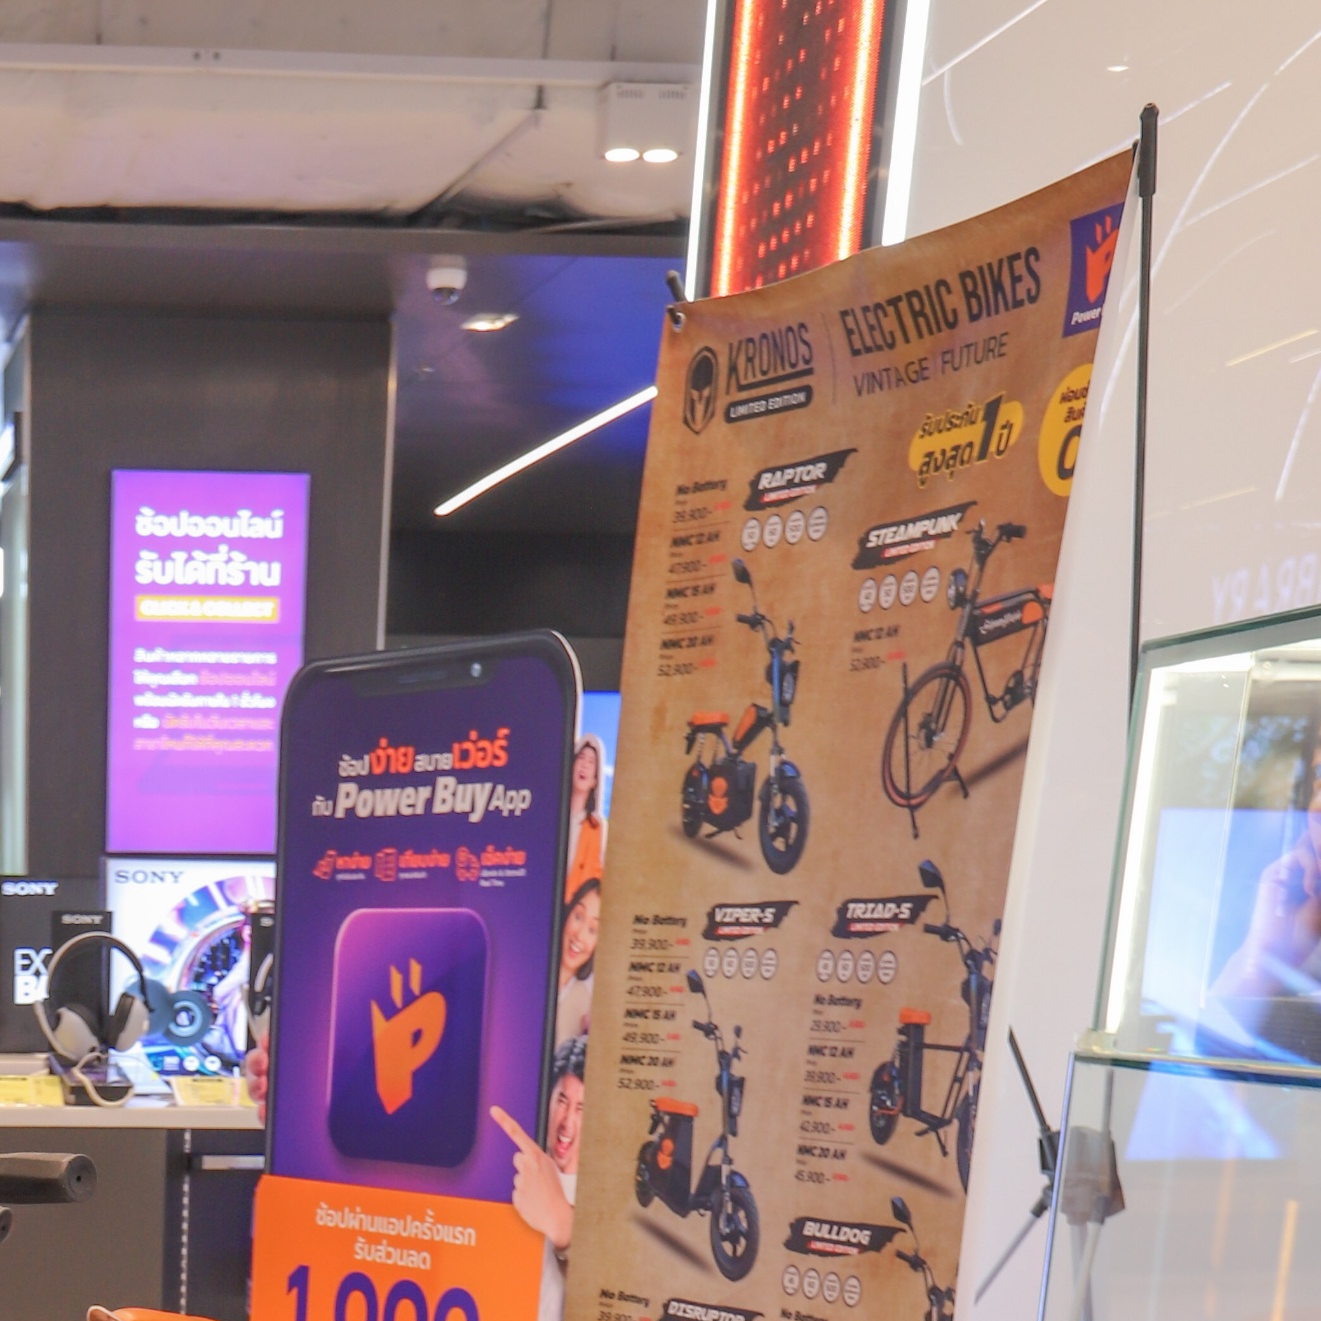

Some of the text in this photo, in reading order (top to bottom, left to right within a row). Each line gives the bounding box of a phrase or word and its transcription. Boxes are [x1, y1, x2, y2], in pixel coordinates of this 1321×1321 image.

[839, 246, 1041, 358] ELECTRIC BIKES
[1071, 306, 1101, 326] Power
[725, 321, 814, 396] KRONOS
[852, 332, 1009, 399] VINTAGE FUTURE
[729, 391, 806, 420] LIMITED EDITION
[919, 402, 979, 439] รับประกัน
[918, 393, 1013, 489] สูงสุด 1 ปี
[757, 462, 827, 490] RAPTOR
[135, 506, 284, 538] ช้อปออนไลน์
[866, 512, 962, 550] STEAMPUNK
[135, 544, 281, 586] รับได้ที่ร้าน
[312, 776, 531, 823] กับ Power Buy App
[1, 881, 58, 896] SONY
[114, 870, 184, 884] SONY
[61, 914, 103, 925] SONY
[652, 915, 687, 927] Battery
[714, 907, 776, 923] VIPER-S
[846, 903, 913, 920] TRIAD-S
[828, 996, 861, 1009] Battery
[316, 1202, 475, 1247] ช้อปผ่านแอปครั้งแรก
[803, 1221, 871, 1245] BULLDOG
[354, 1236, 431, 1270] รับส่วนลด
[618, 1291, 649, 1306] Battery
